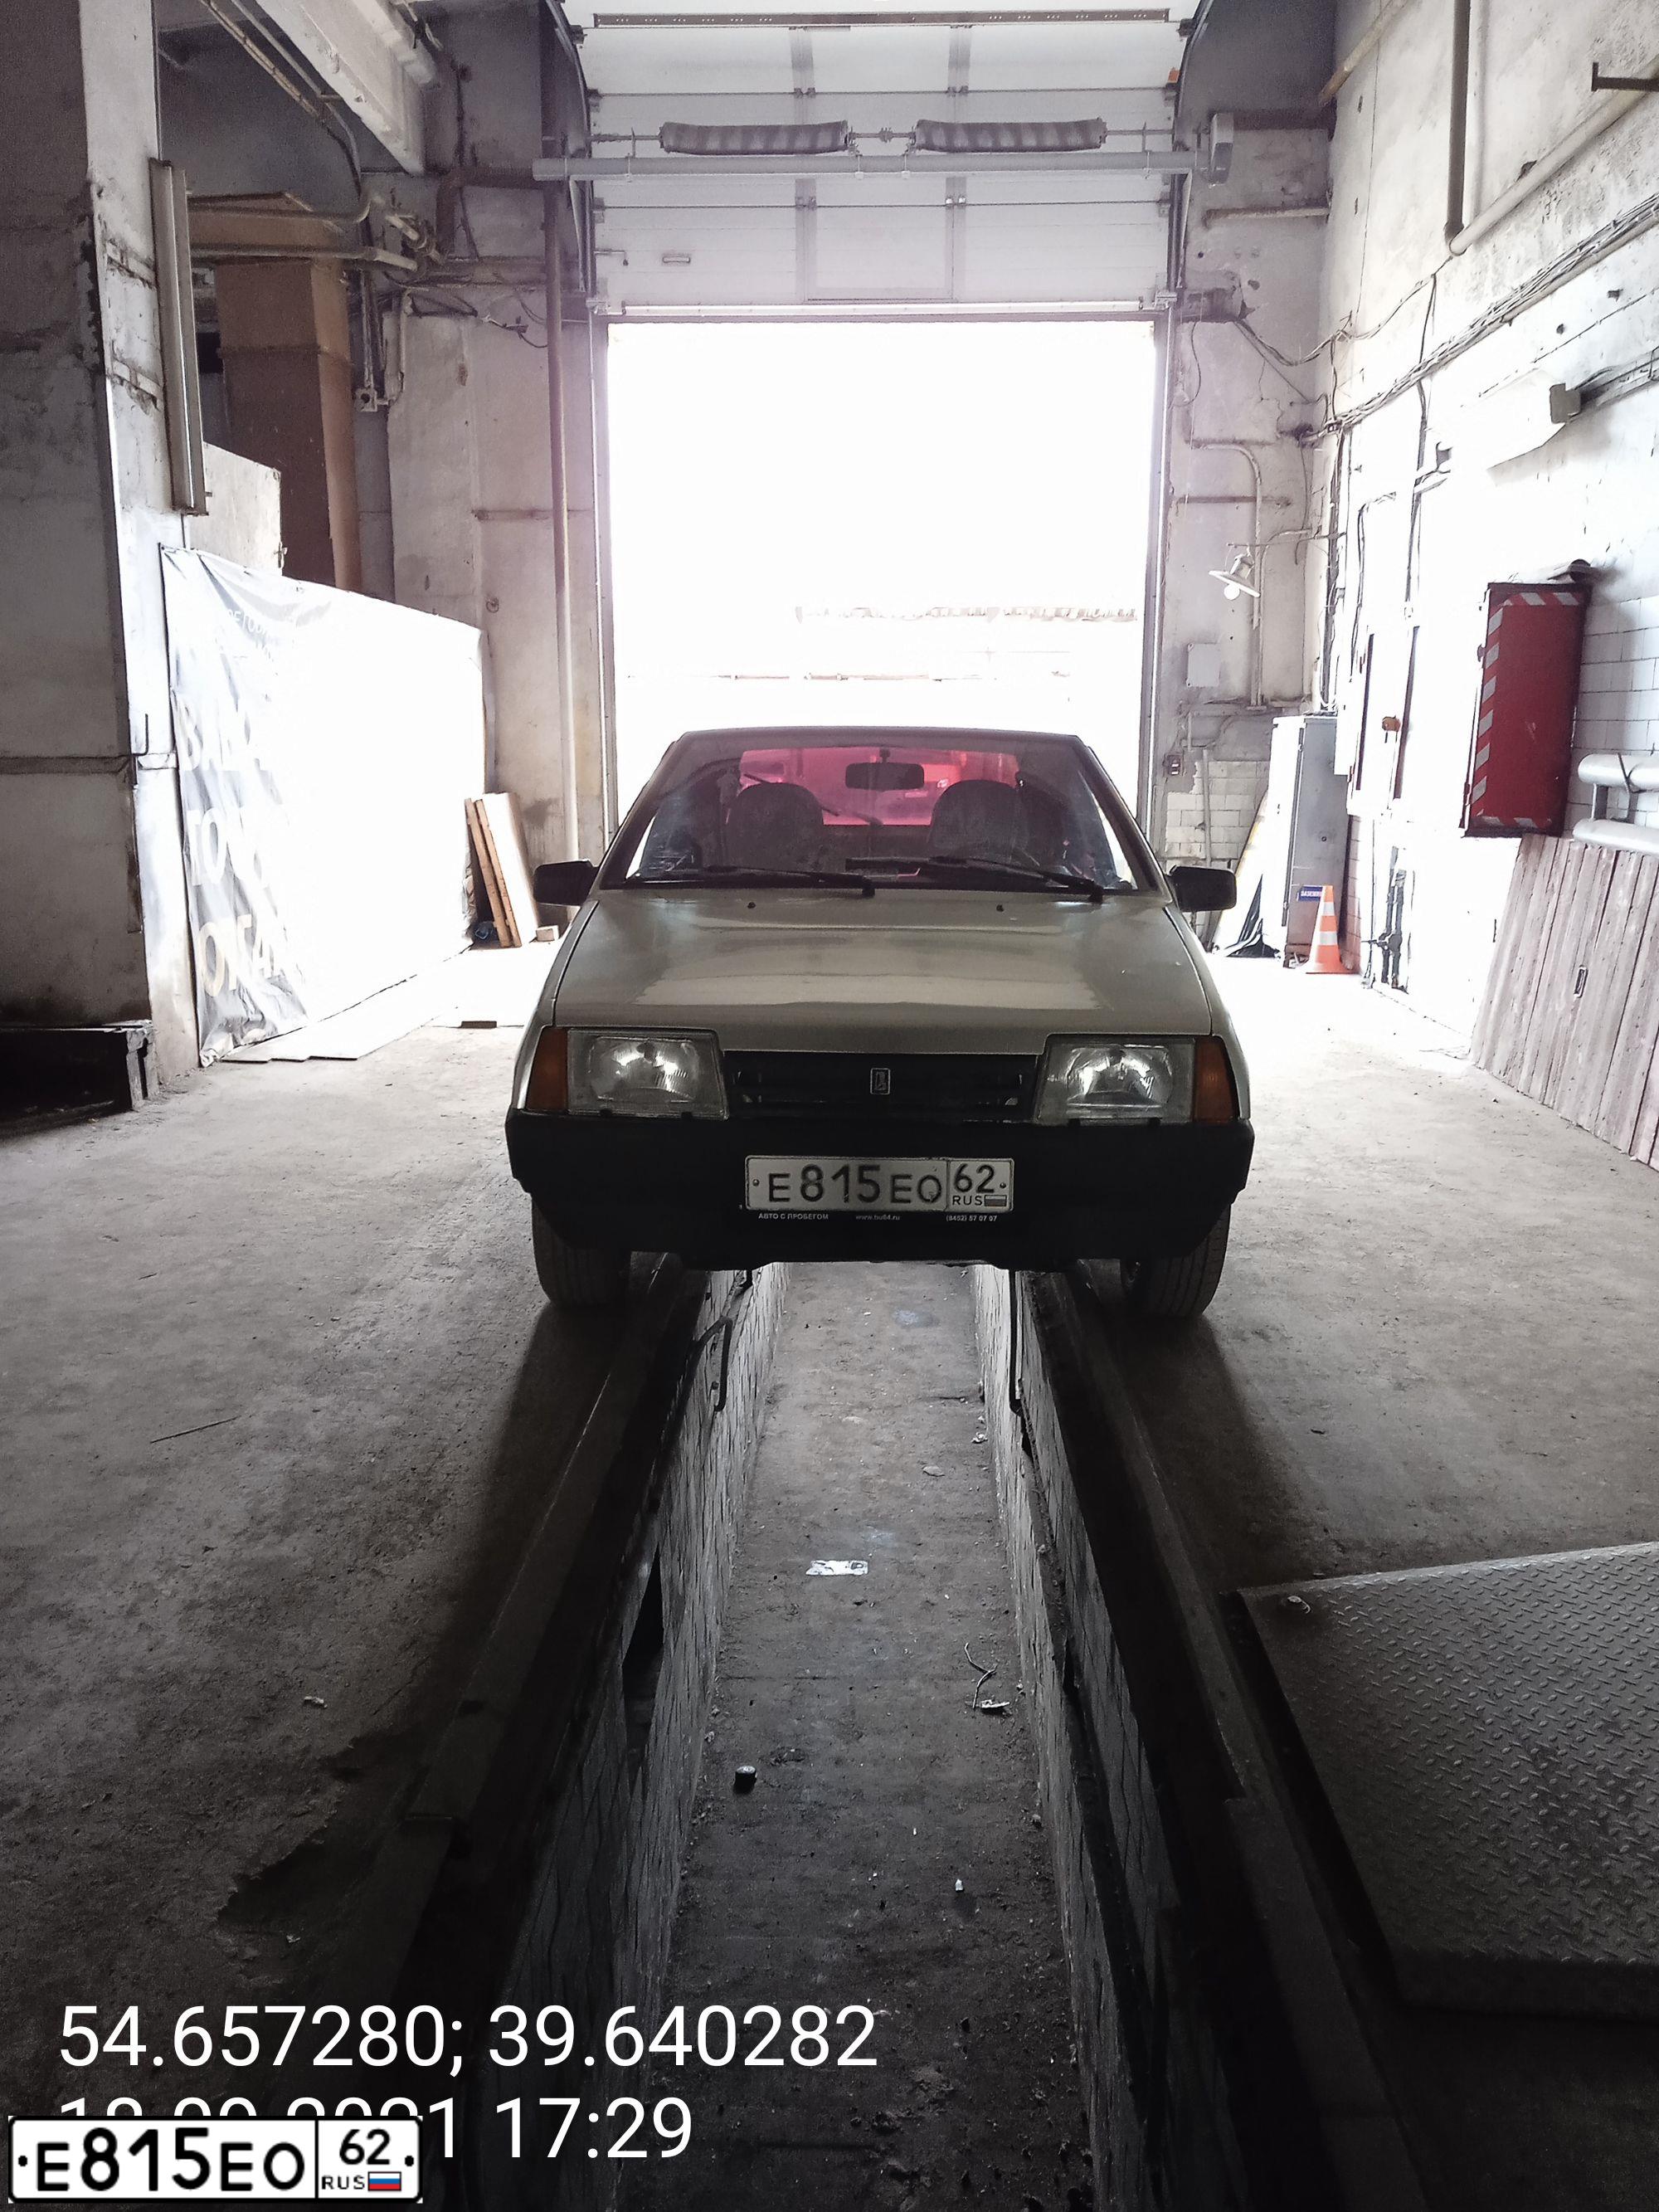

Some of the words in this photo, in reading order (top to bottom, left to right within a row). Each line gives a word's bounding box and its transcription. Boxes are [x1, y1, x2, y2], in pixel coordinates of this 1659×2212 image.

[953, 1162, 995, 1194] 62
[952, 1195, 983, 1206] RUS
[758, 1212, 779, 1220] АВТО
[787, 1212, 830, 1220] ПРОБЕГОМ
